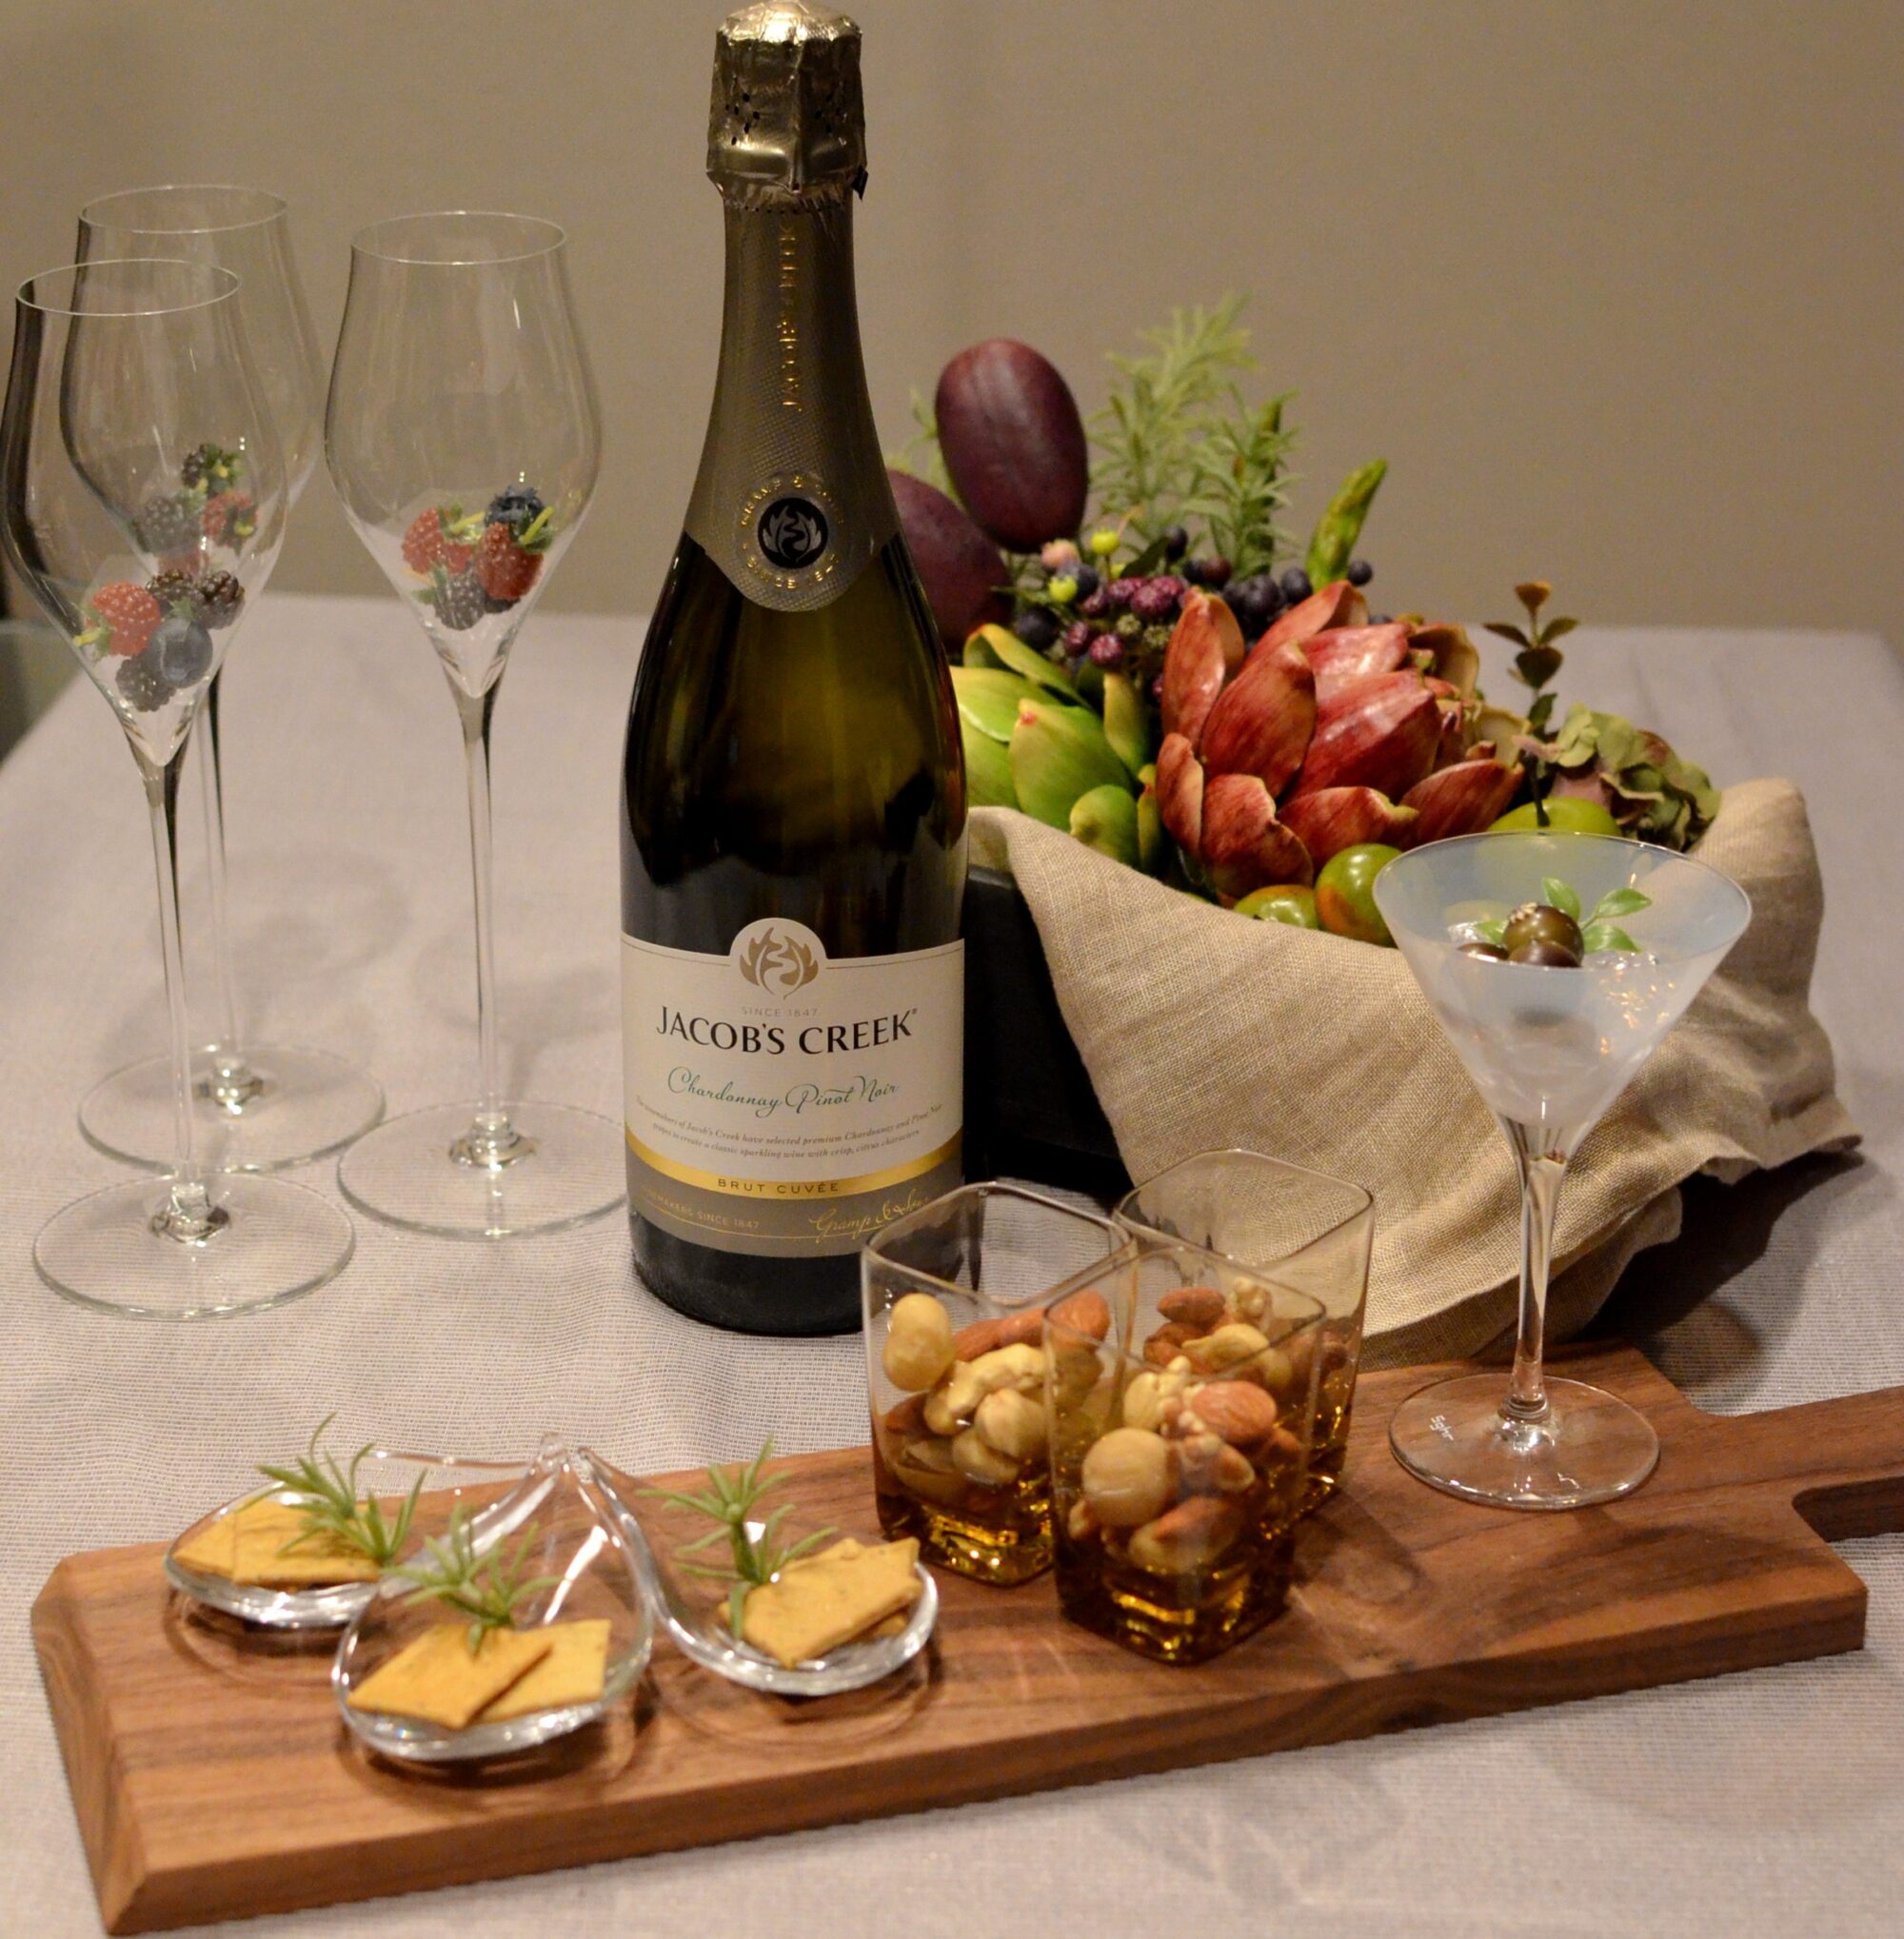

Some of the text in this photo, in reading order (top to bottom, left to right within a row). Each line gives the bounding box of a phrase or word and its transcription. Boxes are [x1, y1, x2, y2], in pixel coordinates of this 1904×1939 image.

[742, 1005, 819, 1018] SINCE 1847
[656, 1006, 785, 1055] JACOB'S
[667, 1066, 899, 1118] Chardonnay Pinot Noir
[715, 1129, 740, 1140] Creek
[743, 1134, 764, 1143] have
[766, 1136, 801, 1145] selected
[803, 1135, 843, 1146] premium
[844, 1125, 894, 1140] Chardonnay
[896, 1118, 909, 1129] and
[711, 1142, 738, 1155] classic
[740, 1147, 781, 1158] sparkling
[783, 1150, 804, 1158] wine
[808, 1149, 828, 1158] with
[856, 1142, 880, 1153] citrus
[718, 1178, 839, 1195] BRUT CUVÉE
